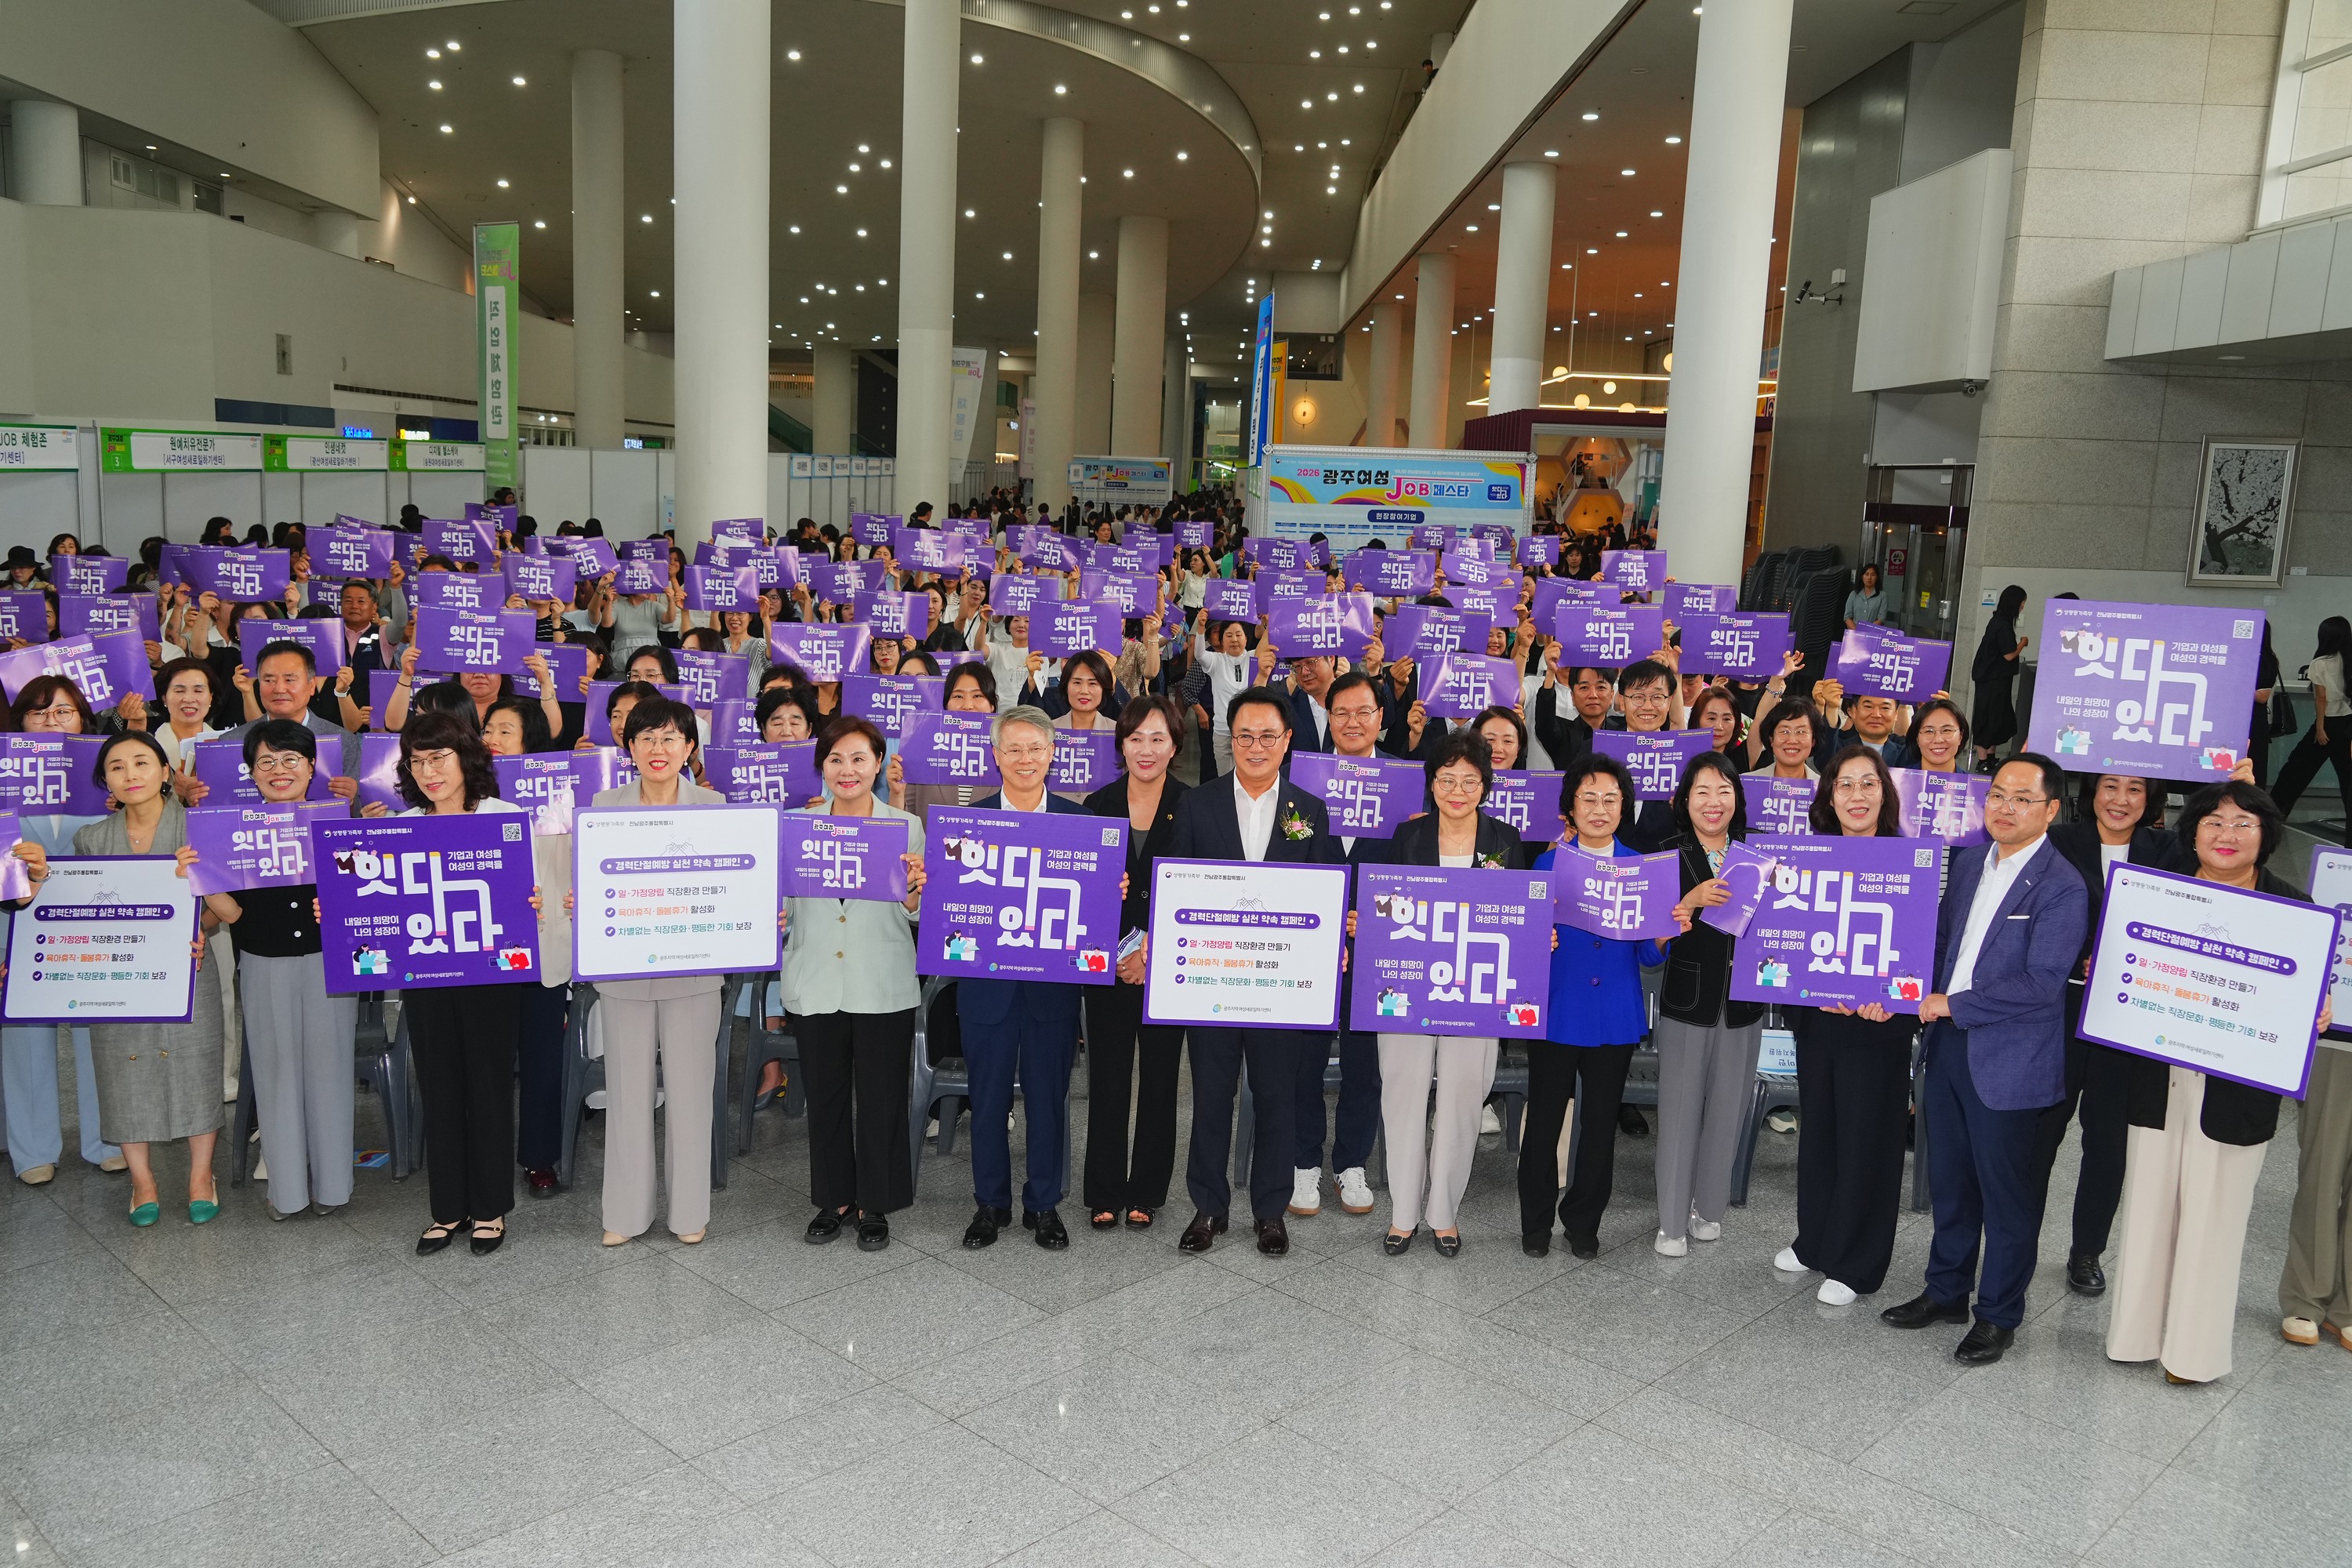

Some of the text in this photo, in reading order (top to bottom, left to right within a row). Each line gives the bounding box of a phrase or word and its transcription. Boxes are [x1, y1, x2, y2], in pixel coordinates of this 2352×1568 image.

[22, 432, 47, 448] 체험존
[169, 436, 216, 452] 원예치유전문가
[114, 456, 120, 467] 3
[1298, 468, 1320, 477] 2026
[1323, 469, 1390, 485] 광주여성
[1386, 478, 1430, 501] JOB
[1432, 485, 1470, 498] 페스타
[1376, 512, 1417, 522] 현장참여기업
[2171, 641, 2229, 655] 기업과 여성을
[2169, 653, 2227, 666] 여성의 경력을
[2056, 695, 2111, 708] 내일의 희망이
[2063, 707, 2109, 719] 나의 성장이
[447, 849, 503, 861] 기업과 여성을
[1047, 849, 1098, 862] 기업과 여성을
[448, 860, 503, 872] 여성의 경력을
[615, 857, 740, 871] 경력단절예방 실천 약속 캠페인
[1046, 860, 1098, 872] 여성의 경력을
[1859, 873, 1911, 884] 기업과 여성을
[667, 887, 699, 896] 직장환경
[702, 886, 727, 895] 만들기
[1858, 884, 1910, 895] 여성의 경력을
[47, 907, 161, 918] 경력단절예방 실천 약속 캠페인
[691, 905, 715, 914] 활성화
[1475, 903, 1526, 914] 기업과 여성을
[344, 915, 400, 927] 내일의 희망이
[1188, 912, 1306, 926] 경력단절예방 실천 약속 캠페인
[1475, 914, 1525, 925] 여성의 경력을
[354, 926, 401, 938] 나의 성장이
[618, 926, 652, 936] 차별없는
[717, 923, 733, 931] 기회
[735, 922, 752, 931] 보장
[91, 935, 122, 944] 직장환경
[1234, 941, 1265, 950] 직장환경
[1267, 942, 1290, 951] 만들기
[2140, 927, 2280, 970] 경력단절예방 실천 약속 캠페인
[111, 953, 134, 962] 활성화
[1255, 960, 1279, 969] 활성화
[1374, 958, 1424, 970] 내일의 희망이
[44, 972, 74, 981] 차별없는
[151, 971, 167, 980] 보장
[1381, 970, 1423, 980] 나의 성장이
[1186, 975, 1218, 985] 차별없는
[1279, 979, 1294, 988] 기회
[2189, 970, 2227, 988] 직장환경
[2228, 980, 2257, 996] 만들기
[2211, 996, 2240, 1012] 활성화
[2130, 996, 2166, 1014] 차별없는
[2237, 1025, 2257, 1038] 기회
[2258, 1030, 2278, 1044] 보장
